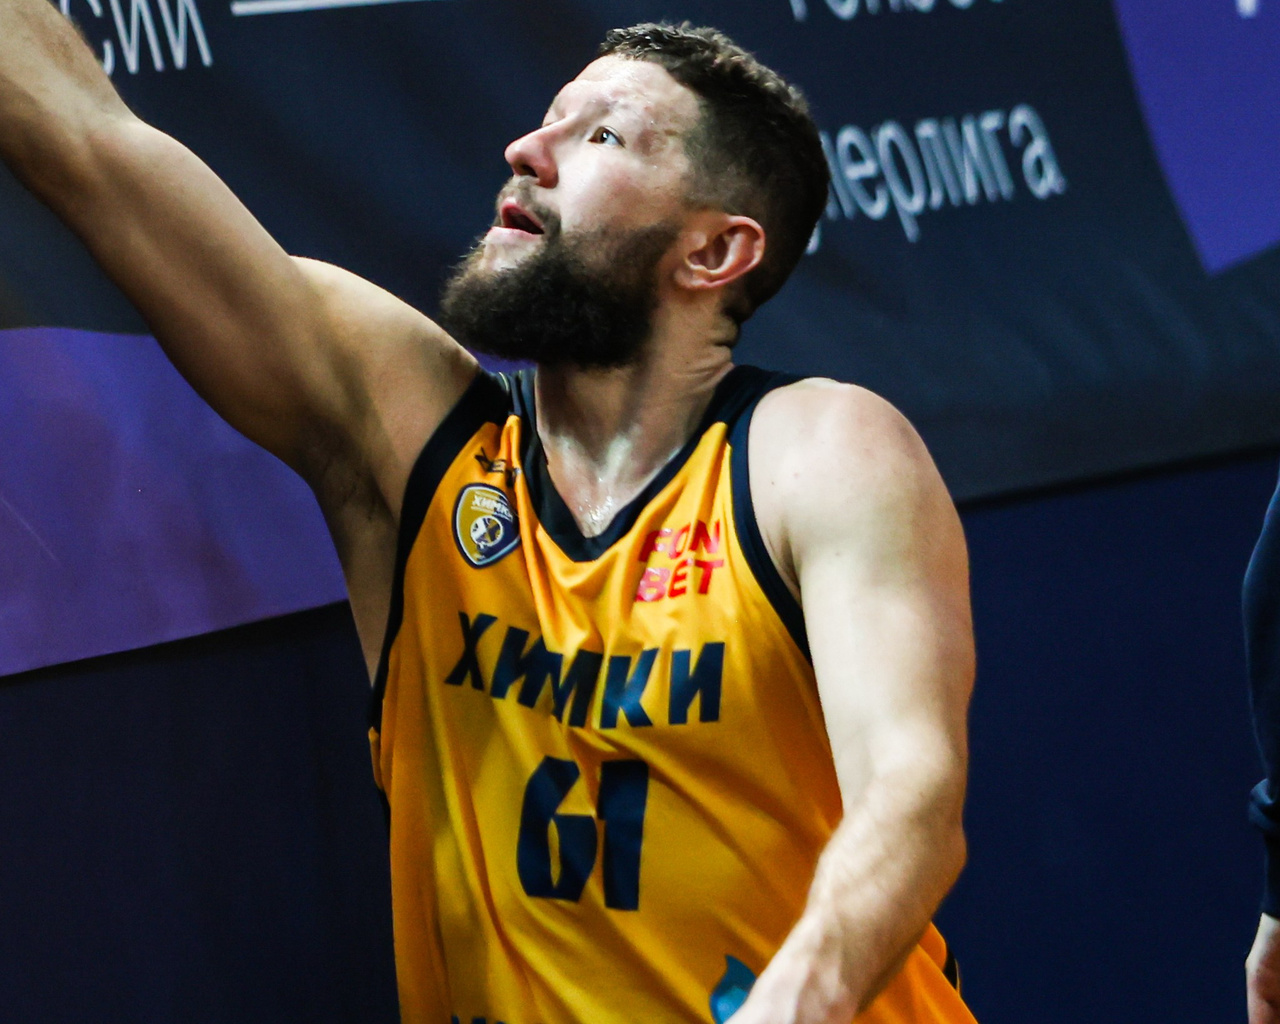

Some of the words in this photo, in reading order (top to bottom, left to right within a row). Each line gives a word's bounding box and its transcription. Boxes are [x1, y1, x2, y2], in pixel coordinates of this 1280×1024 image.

[806, 103, 1067, 255] перлига
[634, 558, 724, 603] BET
[639, 519, 721, 562] FON
[445, 611, 726, 730] ХИМКИ
[517, 755, 649, 912] 61
